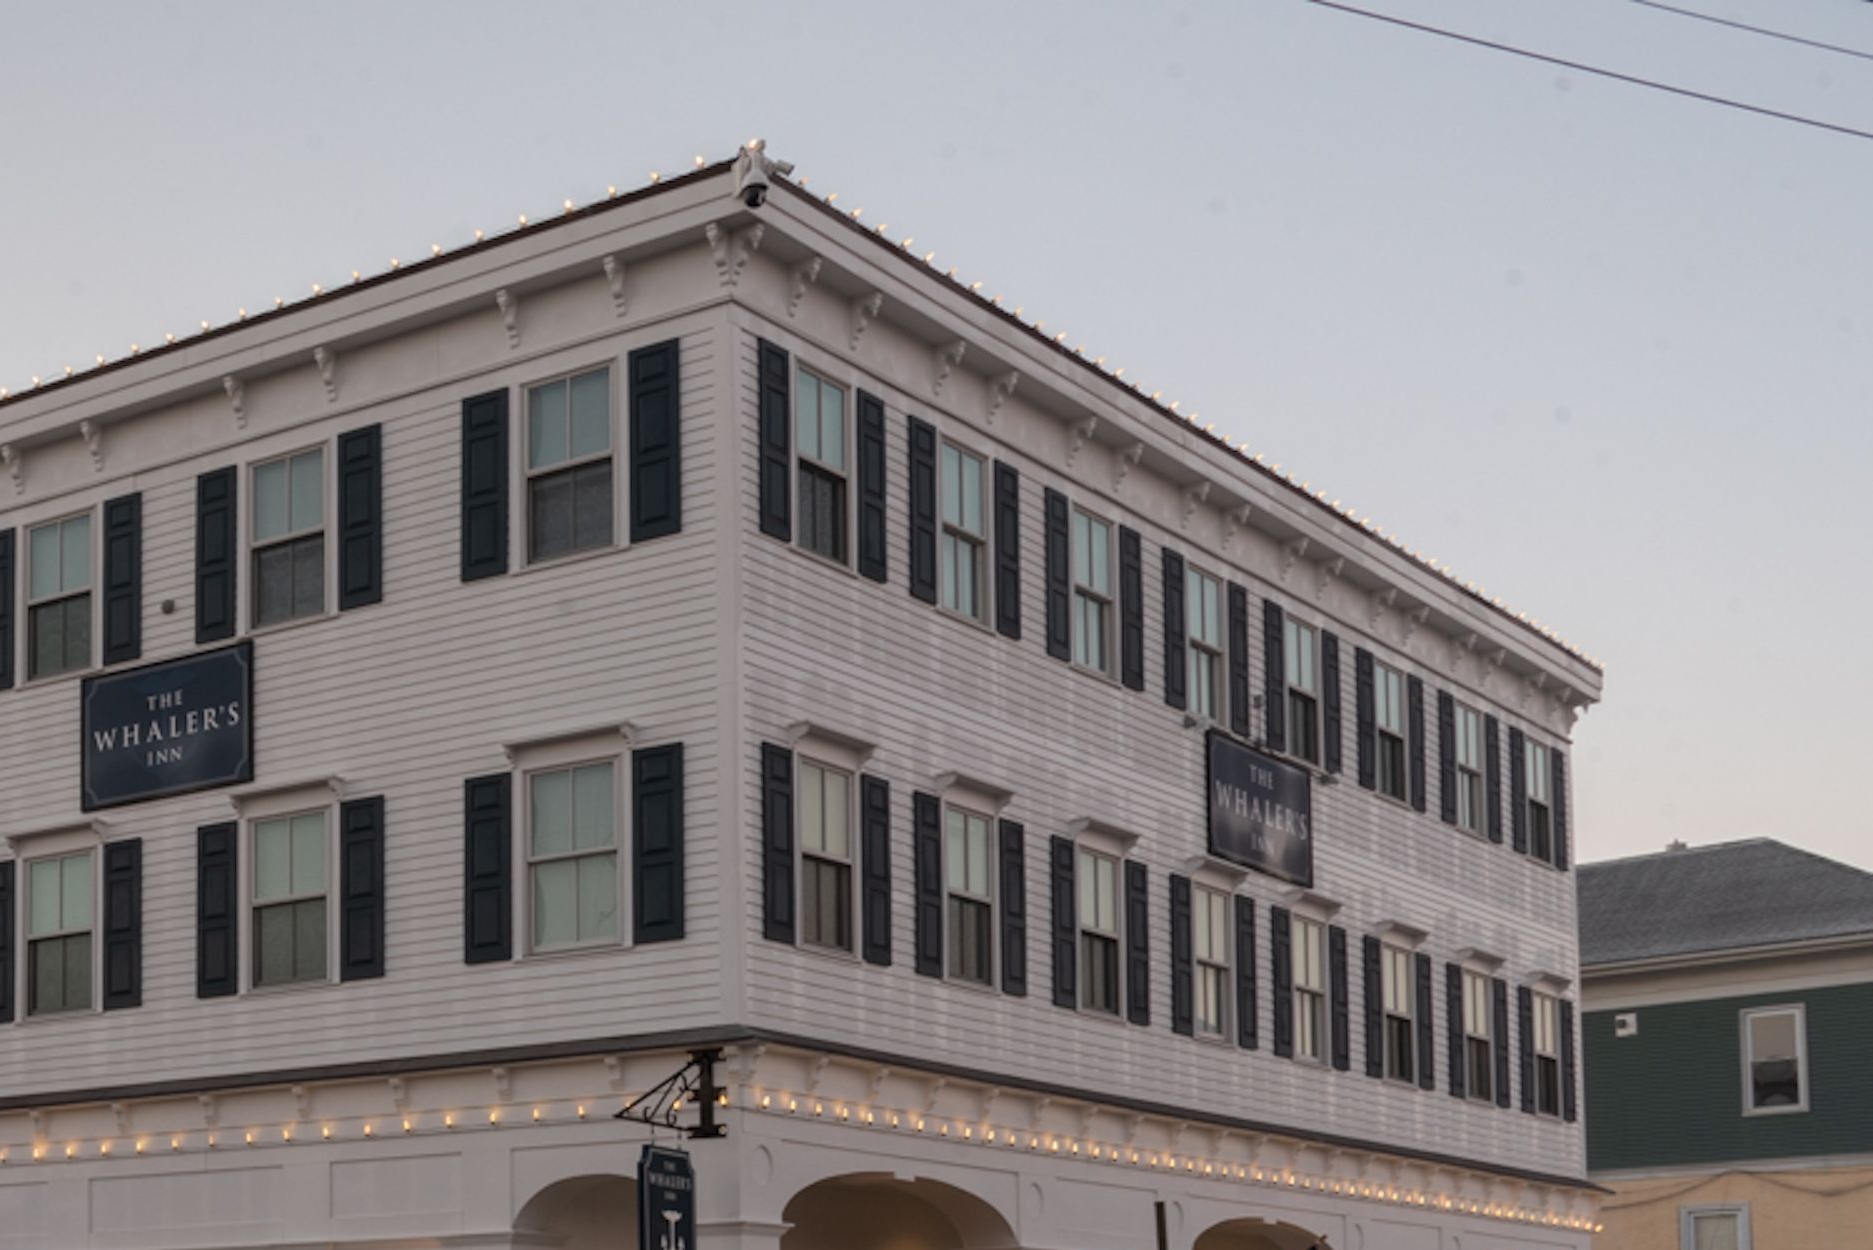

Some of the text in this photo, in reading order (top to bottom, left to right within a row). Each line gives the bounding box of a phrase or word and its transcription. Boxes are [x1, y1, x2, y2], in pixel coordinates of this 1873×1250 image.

[147, 688, 184, 712] THE
[93, 701, 241, 753] WHALER'S
[146, 746, 184, 767] INN
[1248, 763, 1275, 791] THE
[1214, 779, 1308, 841] WHALER'S
